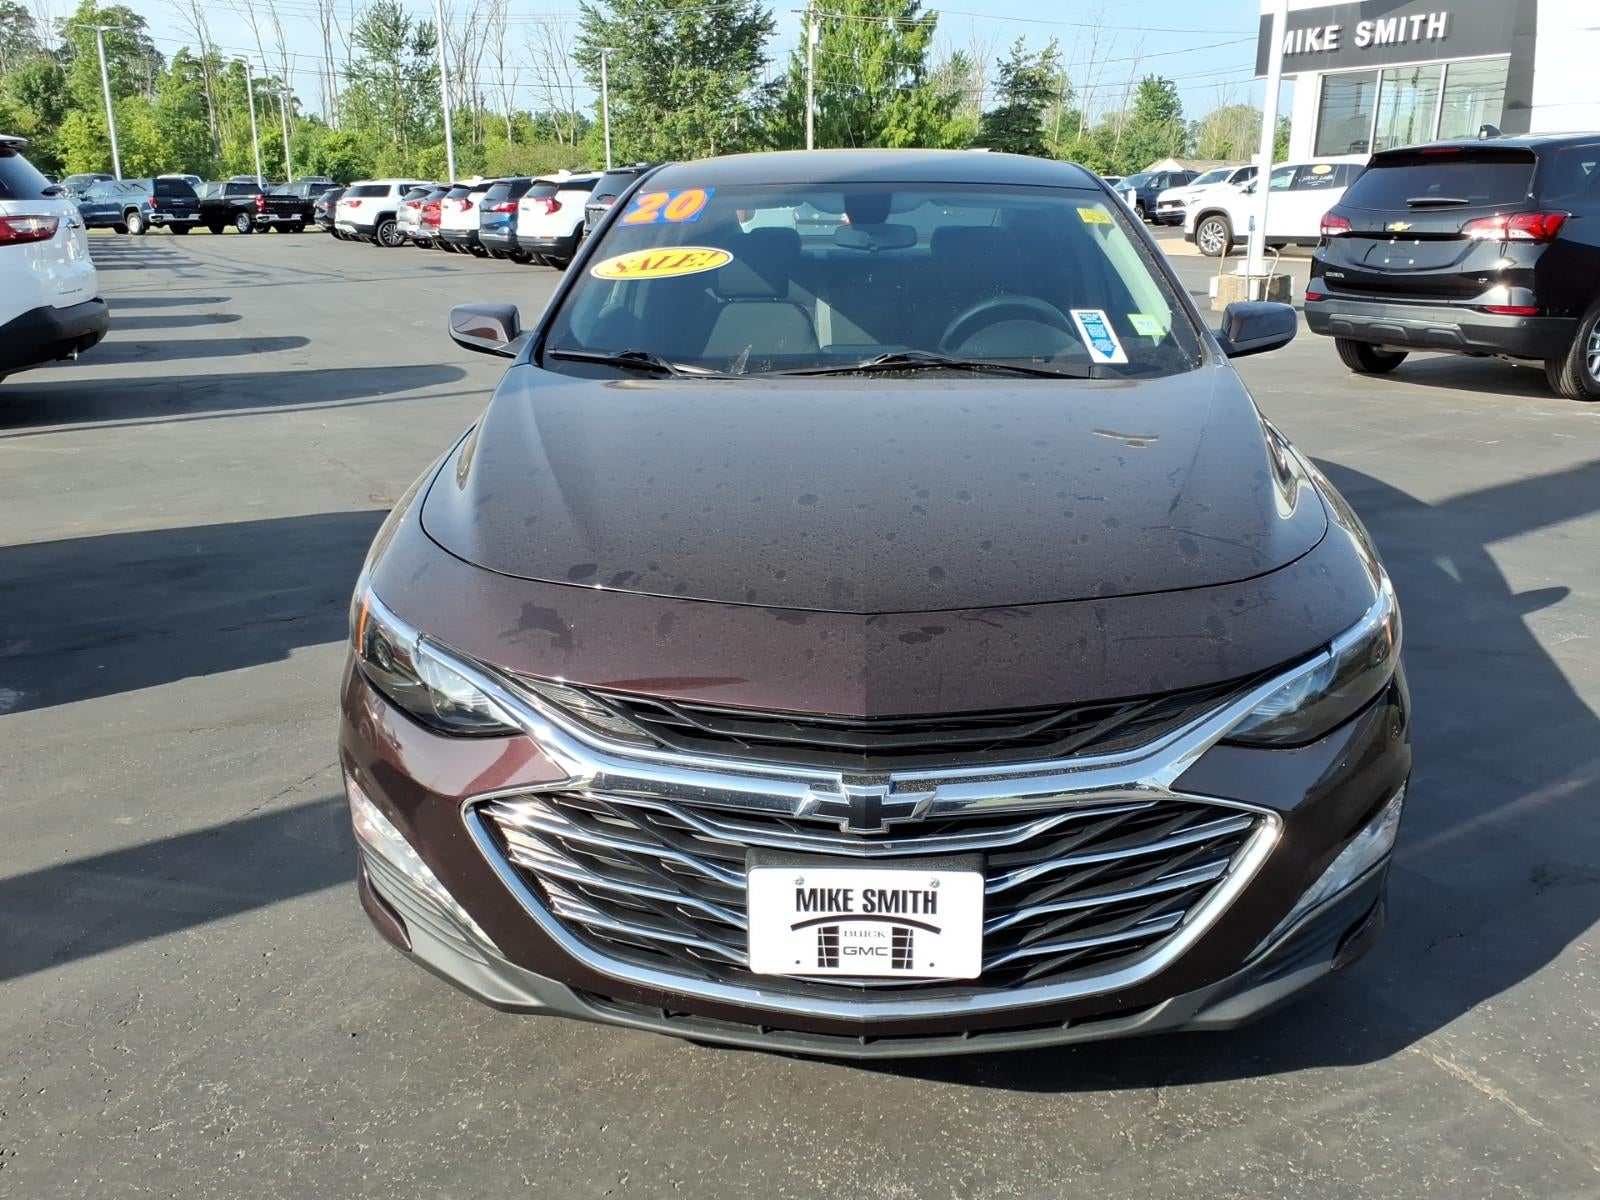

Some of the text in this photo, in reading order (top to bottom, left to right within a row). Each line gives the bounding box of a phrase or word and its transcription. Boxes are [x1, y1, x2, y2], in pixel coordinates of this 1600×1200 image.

[1354, 12, 1447, 47] SMITH
[623, 189, 707, 224] 20
[606, 251, 719, 275] SALE!
[795, 888, 937, 914] MIKE SMITH
[843, 930, 886, 938] BUICK
[843, 946, 888, 956] GMC
